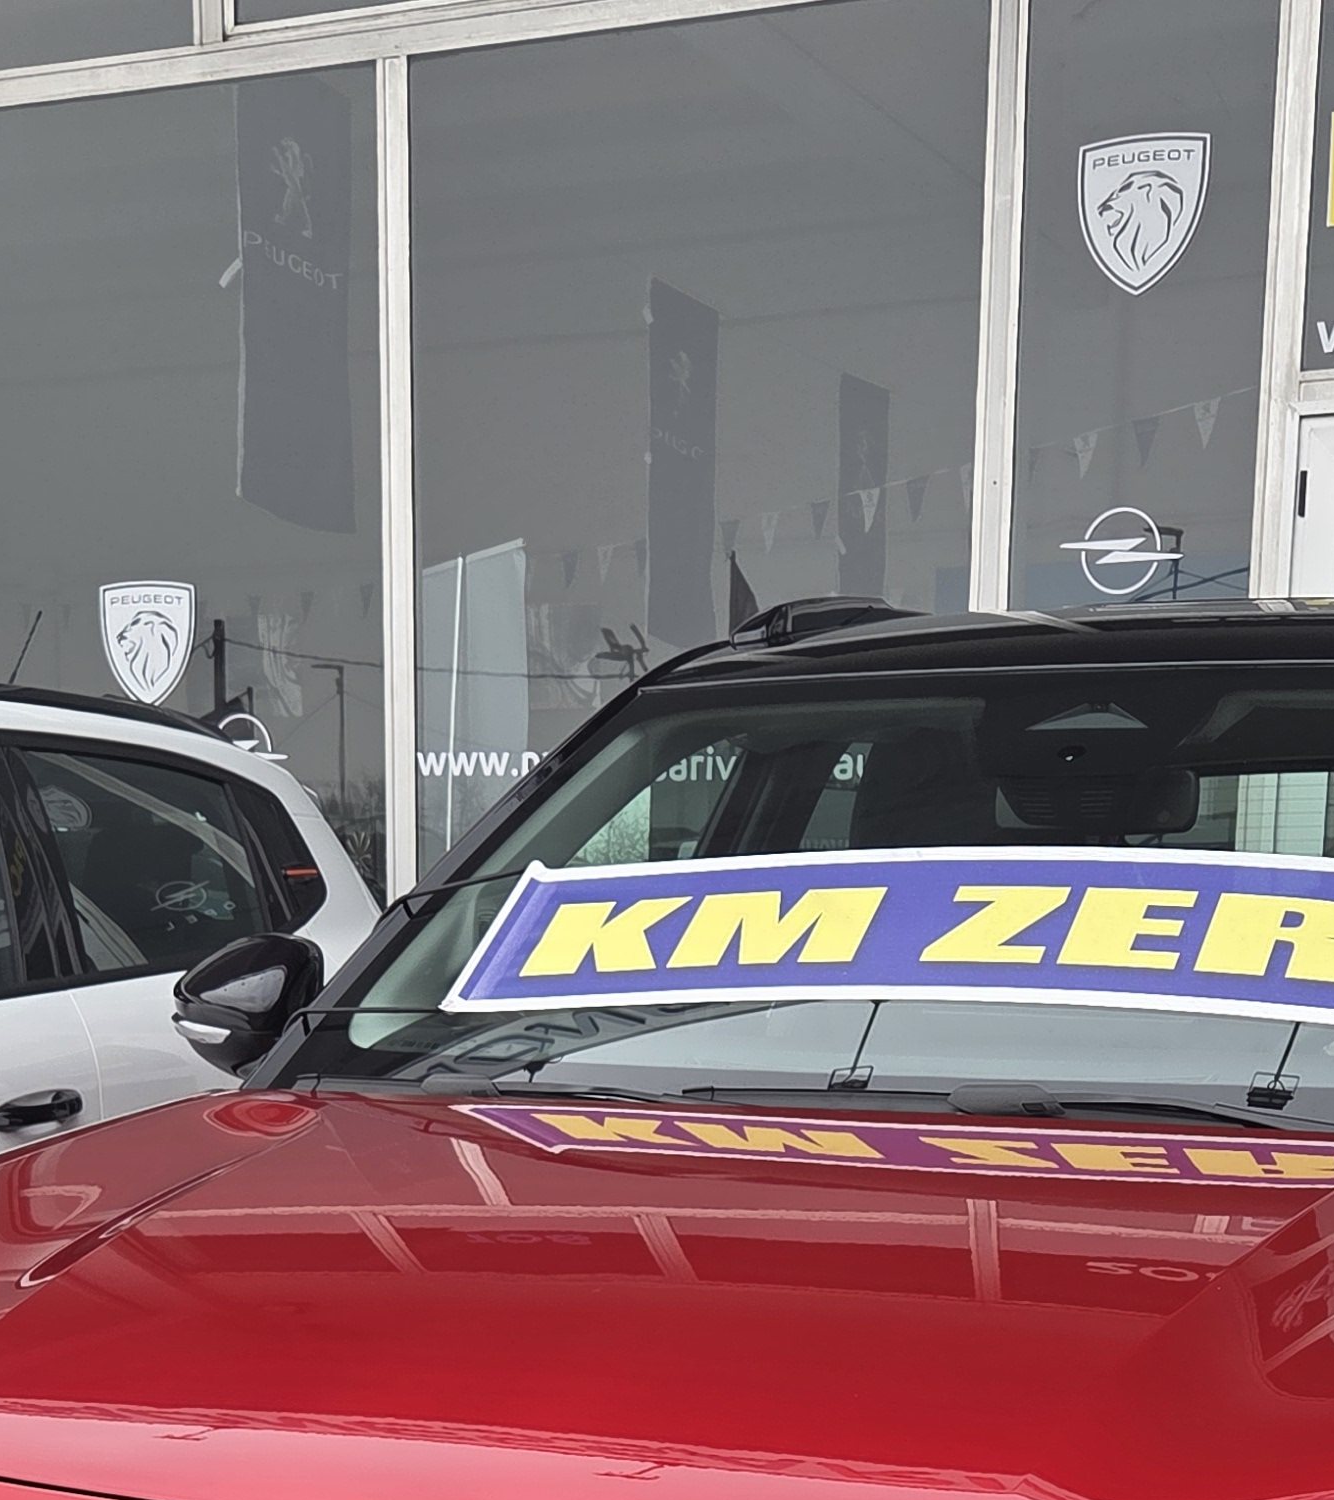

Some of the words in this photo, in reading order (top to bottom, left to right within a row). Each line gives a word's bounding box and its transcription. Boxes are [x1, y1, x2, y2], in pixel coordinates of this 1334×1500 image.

[1092, 148, 1196, 170] PEUGEOT
[110, 593, 184, 606] PEUGEOT
[520, 887, 884, 976] KM
